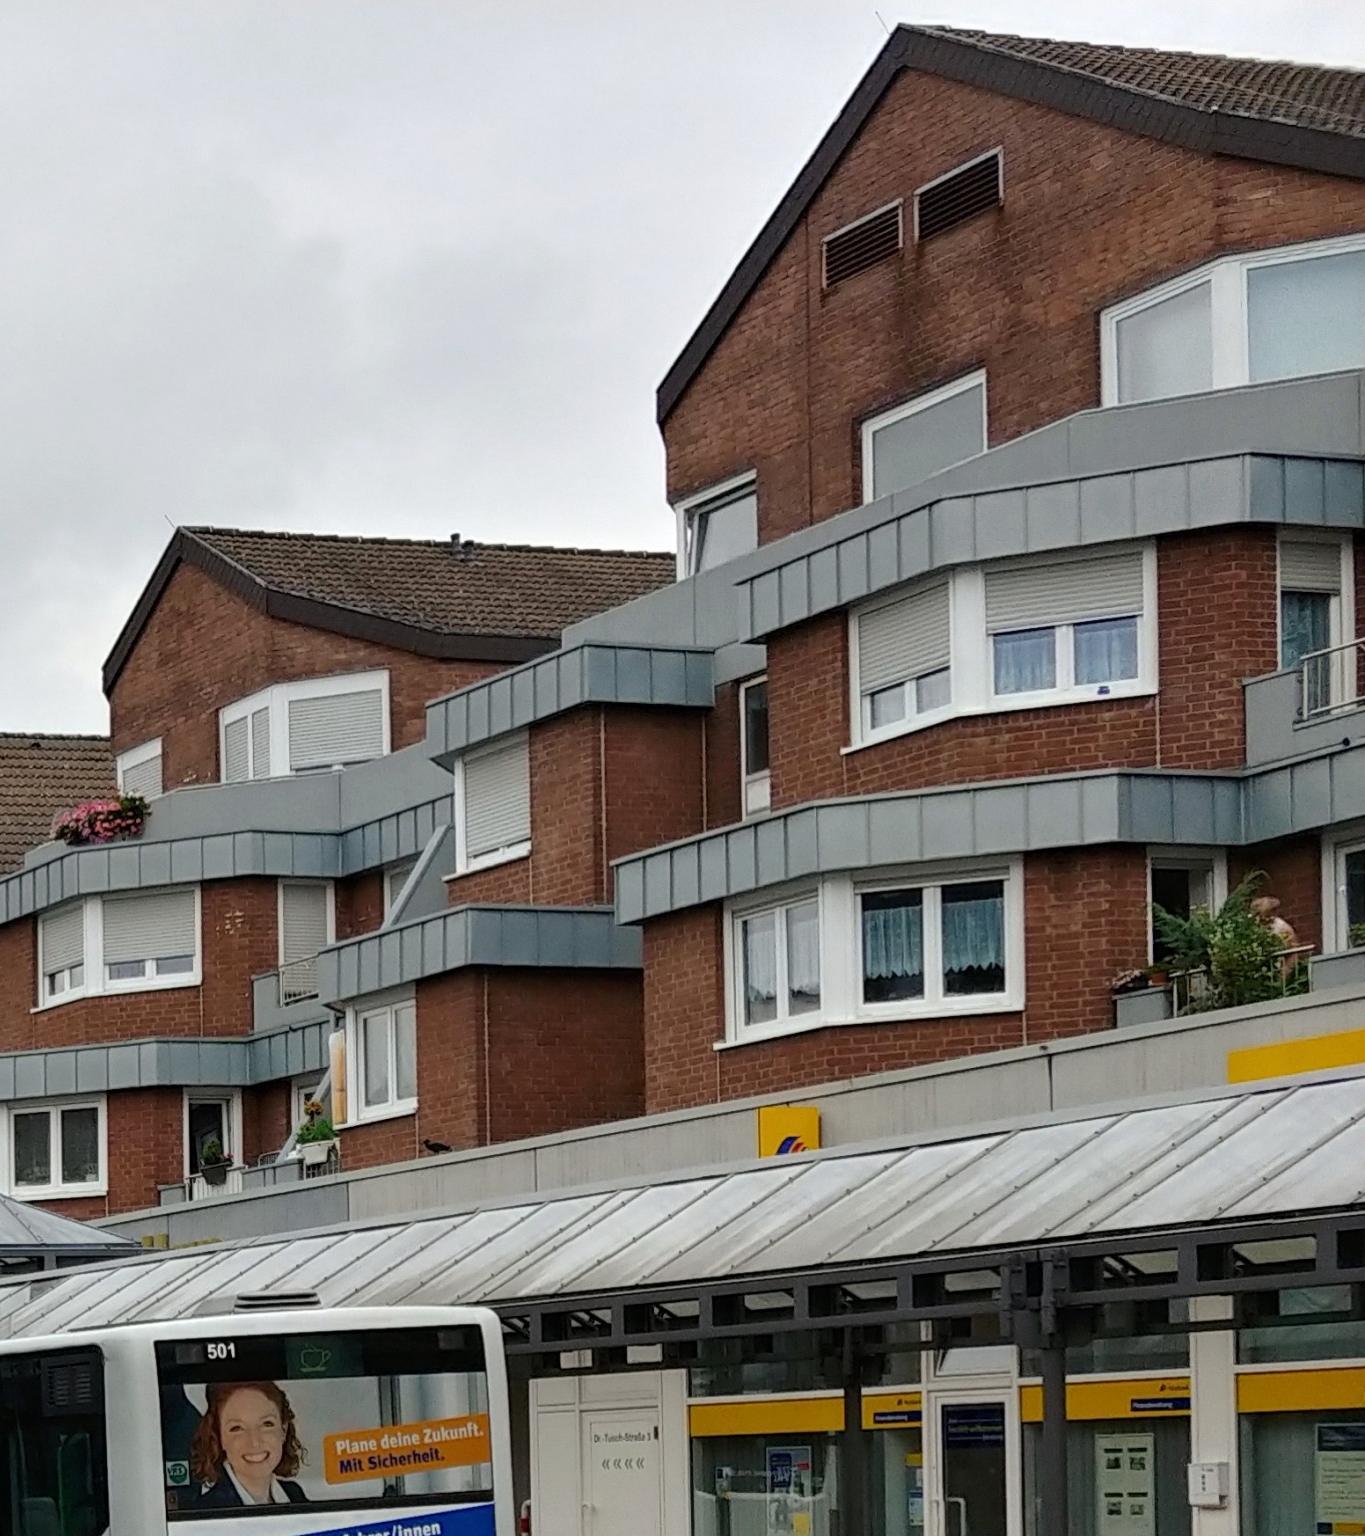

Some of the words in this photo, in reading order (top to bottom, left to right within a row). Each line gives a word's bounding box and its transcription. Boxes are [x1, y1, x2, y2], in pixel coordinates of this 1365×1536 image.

[207, 1343, 236, 1359] 501
[335, 1438, 377, 1456] Plane
[380, 1431, 420, 1449] deine
[423, 1423, 484, 1444] Zukunft.
[339, 1457, 363, 1474] Mit
[368, 1449, 445, 1470] Sicherheit.
